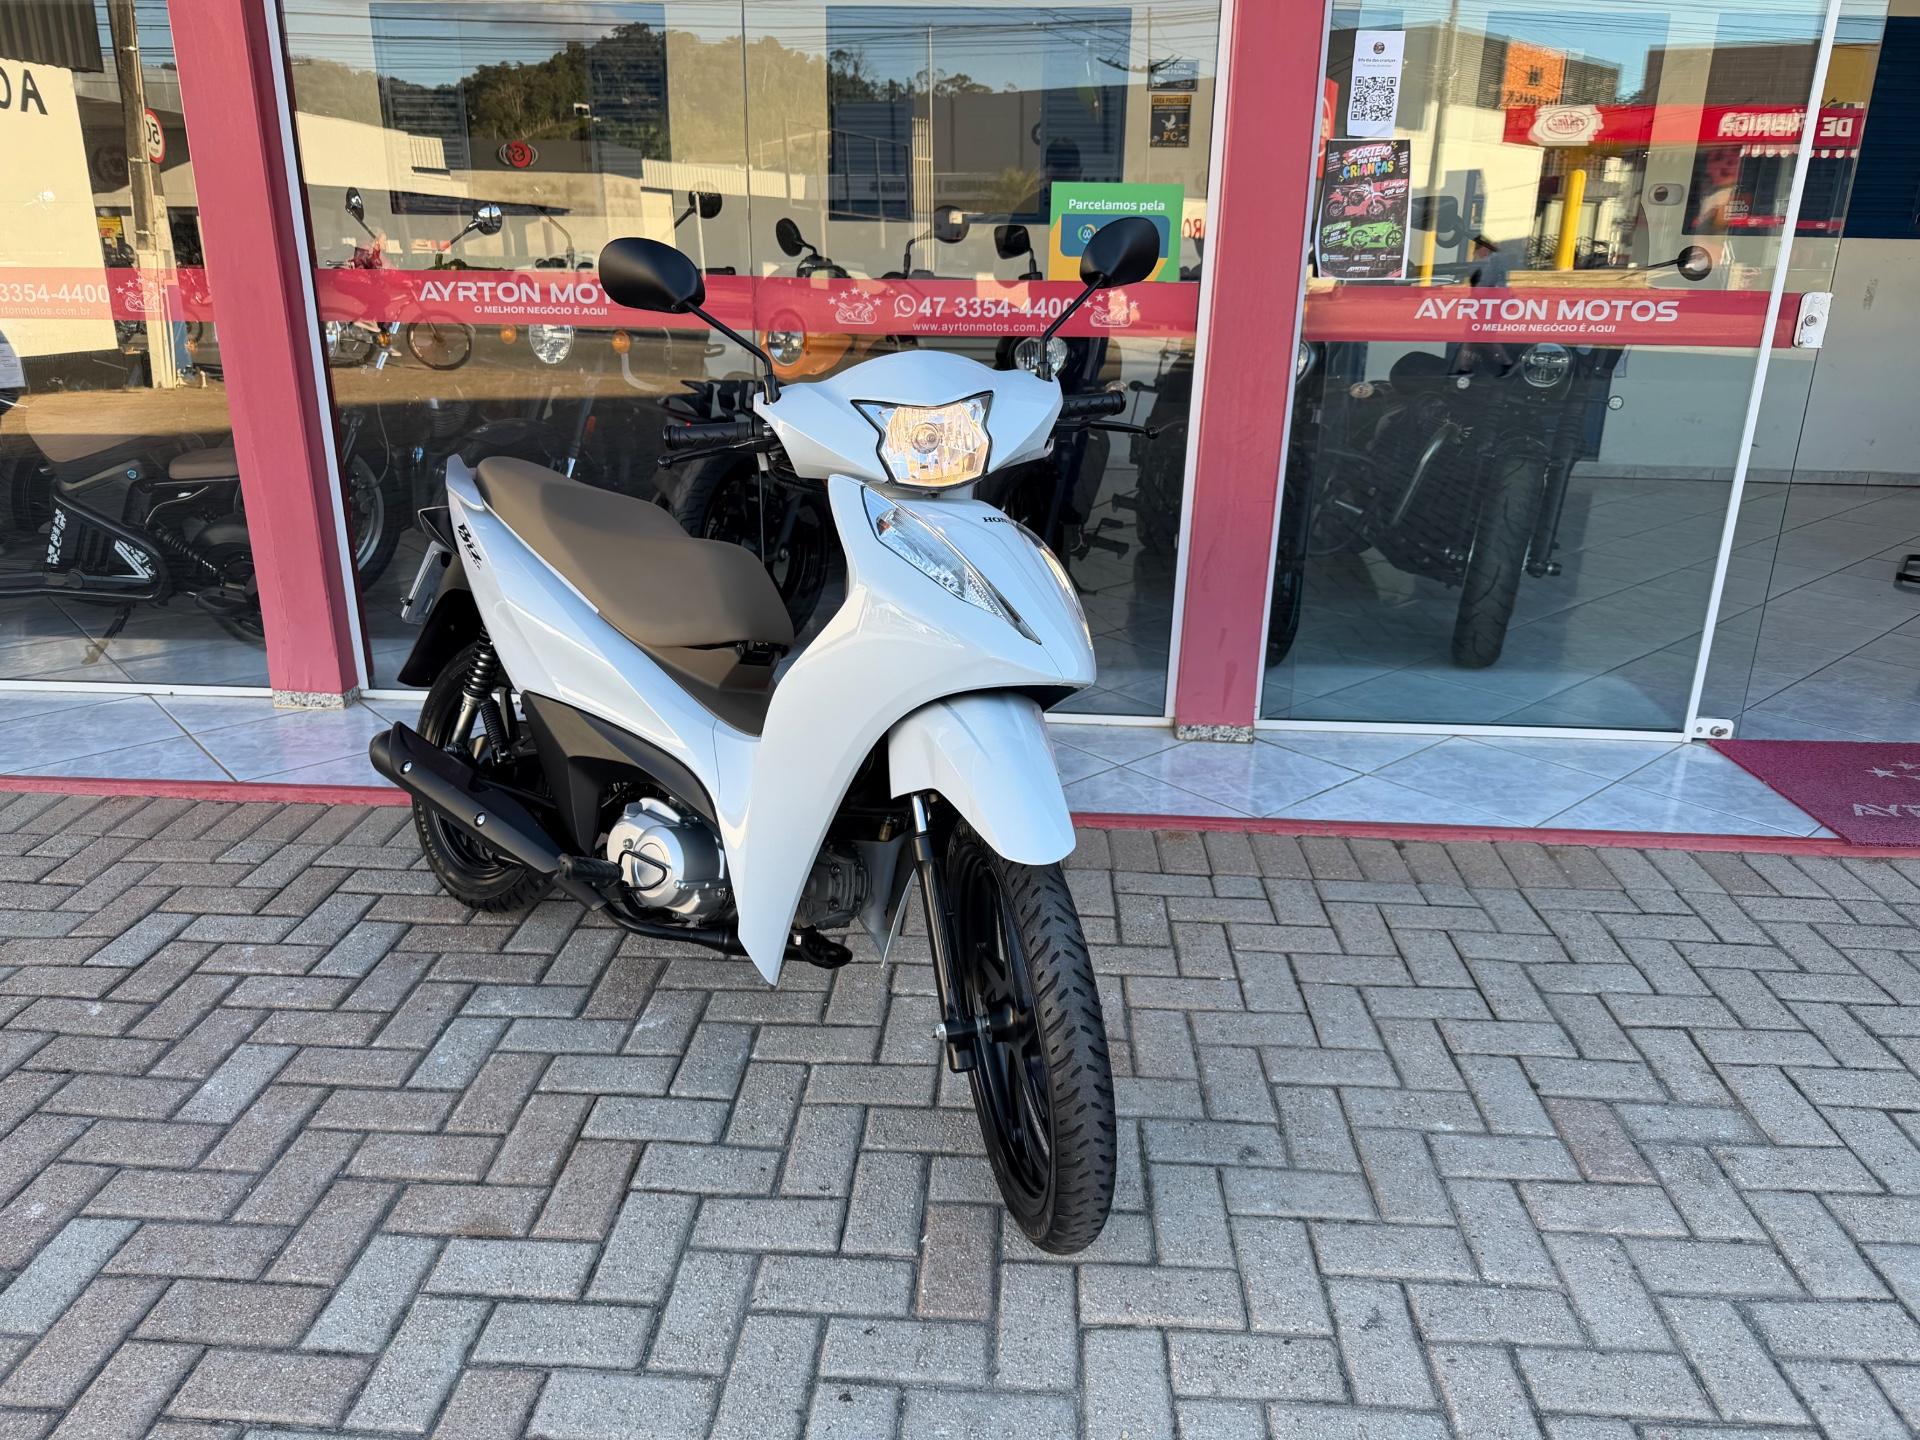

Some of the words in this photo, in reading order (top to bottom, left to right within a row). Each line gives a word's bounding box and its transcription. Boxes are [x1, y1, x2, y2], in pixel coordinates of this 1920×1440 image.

[1348, 146, 1392, 162] SORTEIO
[1068, 199, 1137, 211] Parcelamos
[1139, 200, 1165, 212] pela
[0, 283, 110, 303] 3354-4400
[420, 281, 541, 304] AYRTON
[0, 306, 91, 316] rtonmotos.com.br
[474, 305, 481, 314] O
[484, 306, 525, 315] MELHOR
[527, 305, 572, 316] NEGÓCIO
[574, 305, 580, 316] É
[582, 308, 608, 316] AQUI
[918, 296, 946, 317] 47
[1414, 298, 1548, 321] AYRTON
[1556, 300, 1680, 322] MOTOS
[912, 322, 1051, 333] www.ayrtonmotos.com.b
[1471, 323, 1480, 331] O
[1482, 323, 1526, 332] MELHOR
[1528, 322, 1577, 333] NEGÓCIO
[1579, 322, 1586, 333] É
[1588, 325, 1616, 333] AQUI
[457, 522, 483, 562] Biz
